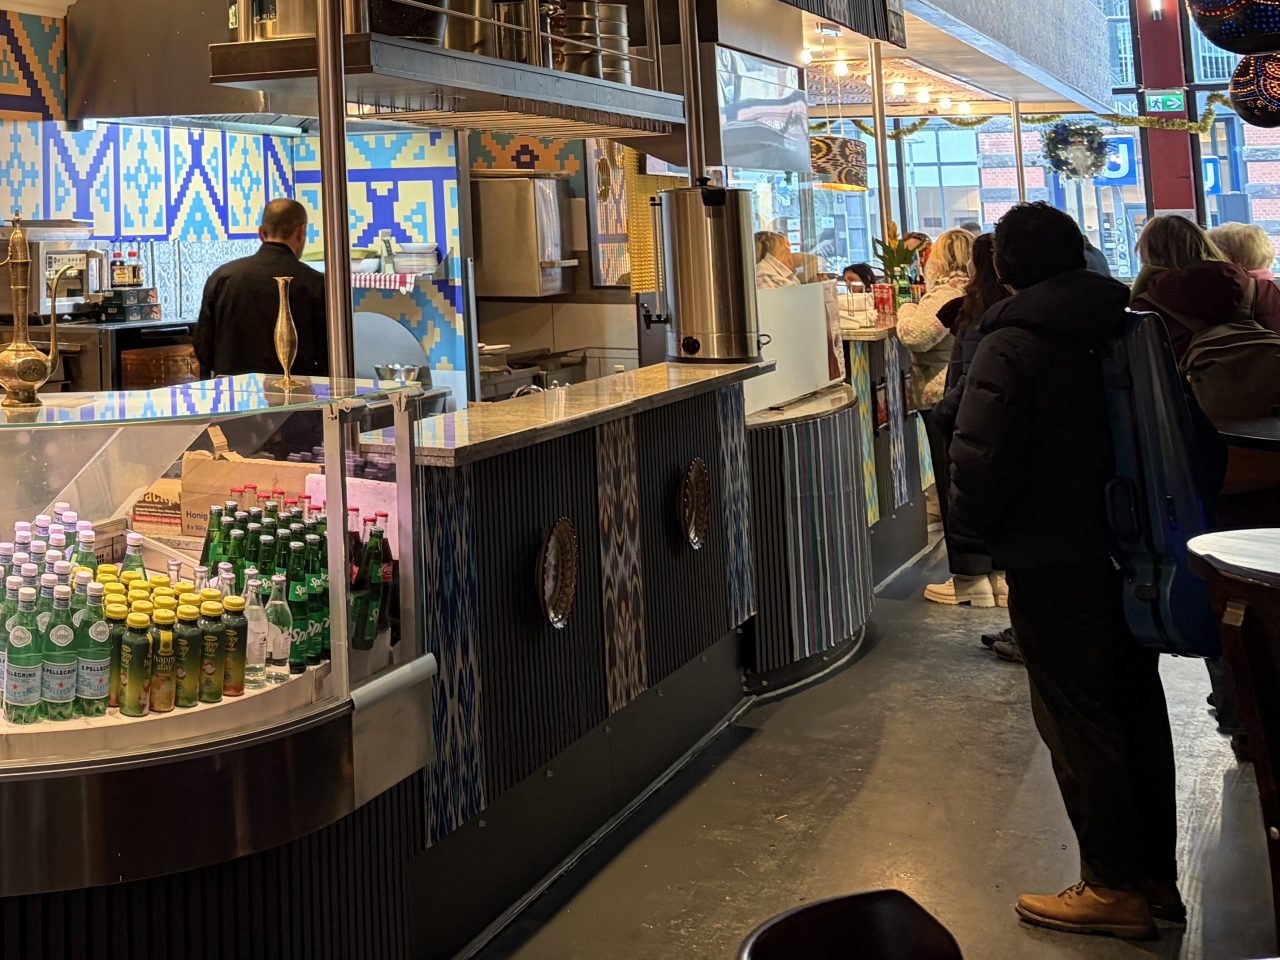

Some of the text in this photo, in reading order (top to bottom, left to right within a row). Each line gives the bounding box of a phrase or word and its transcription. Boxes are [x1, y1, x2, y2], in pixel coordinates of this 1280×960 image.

[186, 510, 208, 521] Honig
[153, 654, 176, 665] happy
[157, 663, 173, 672] day
